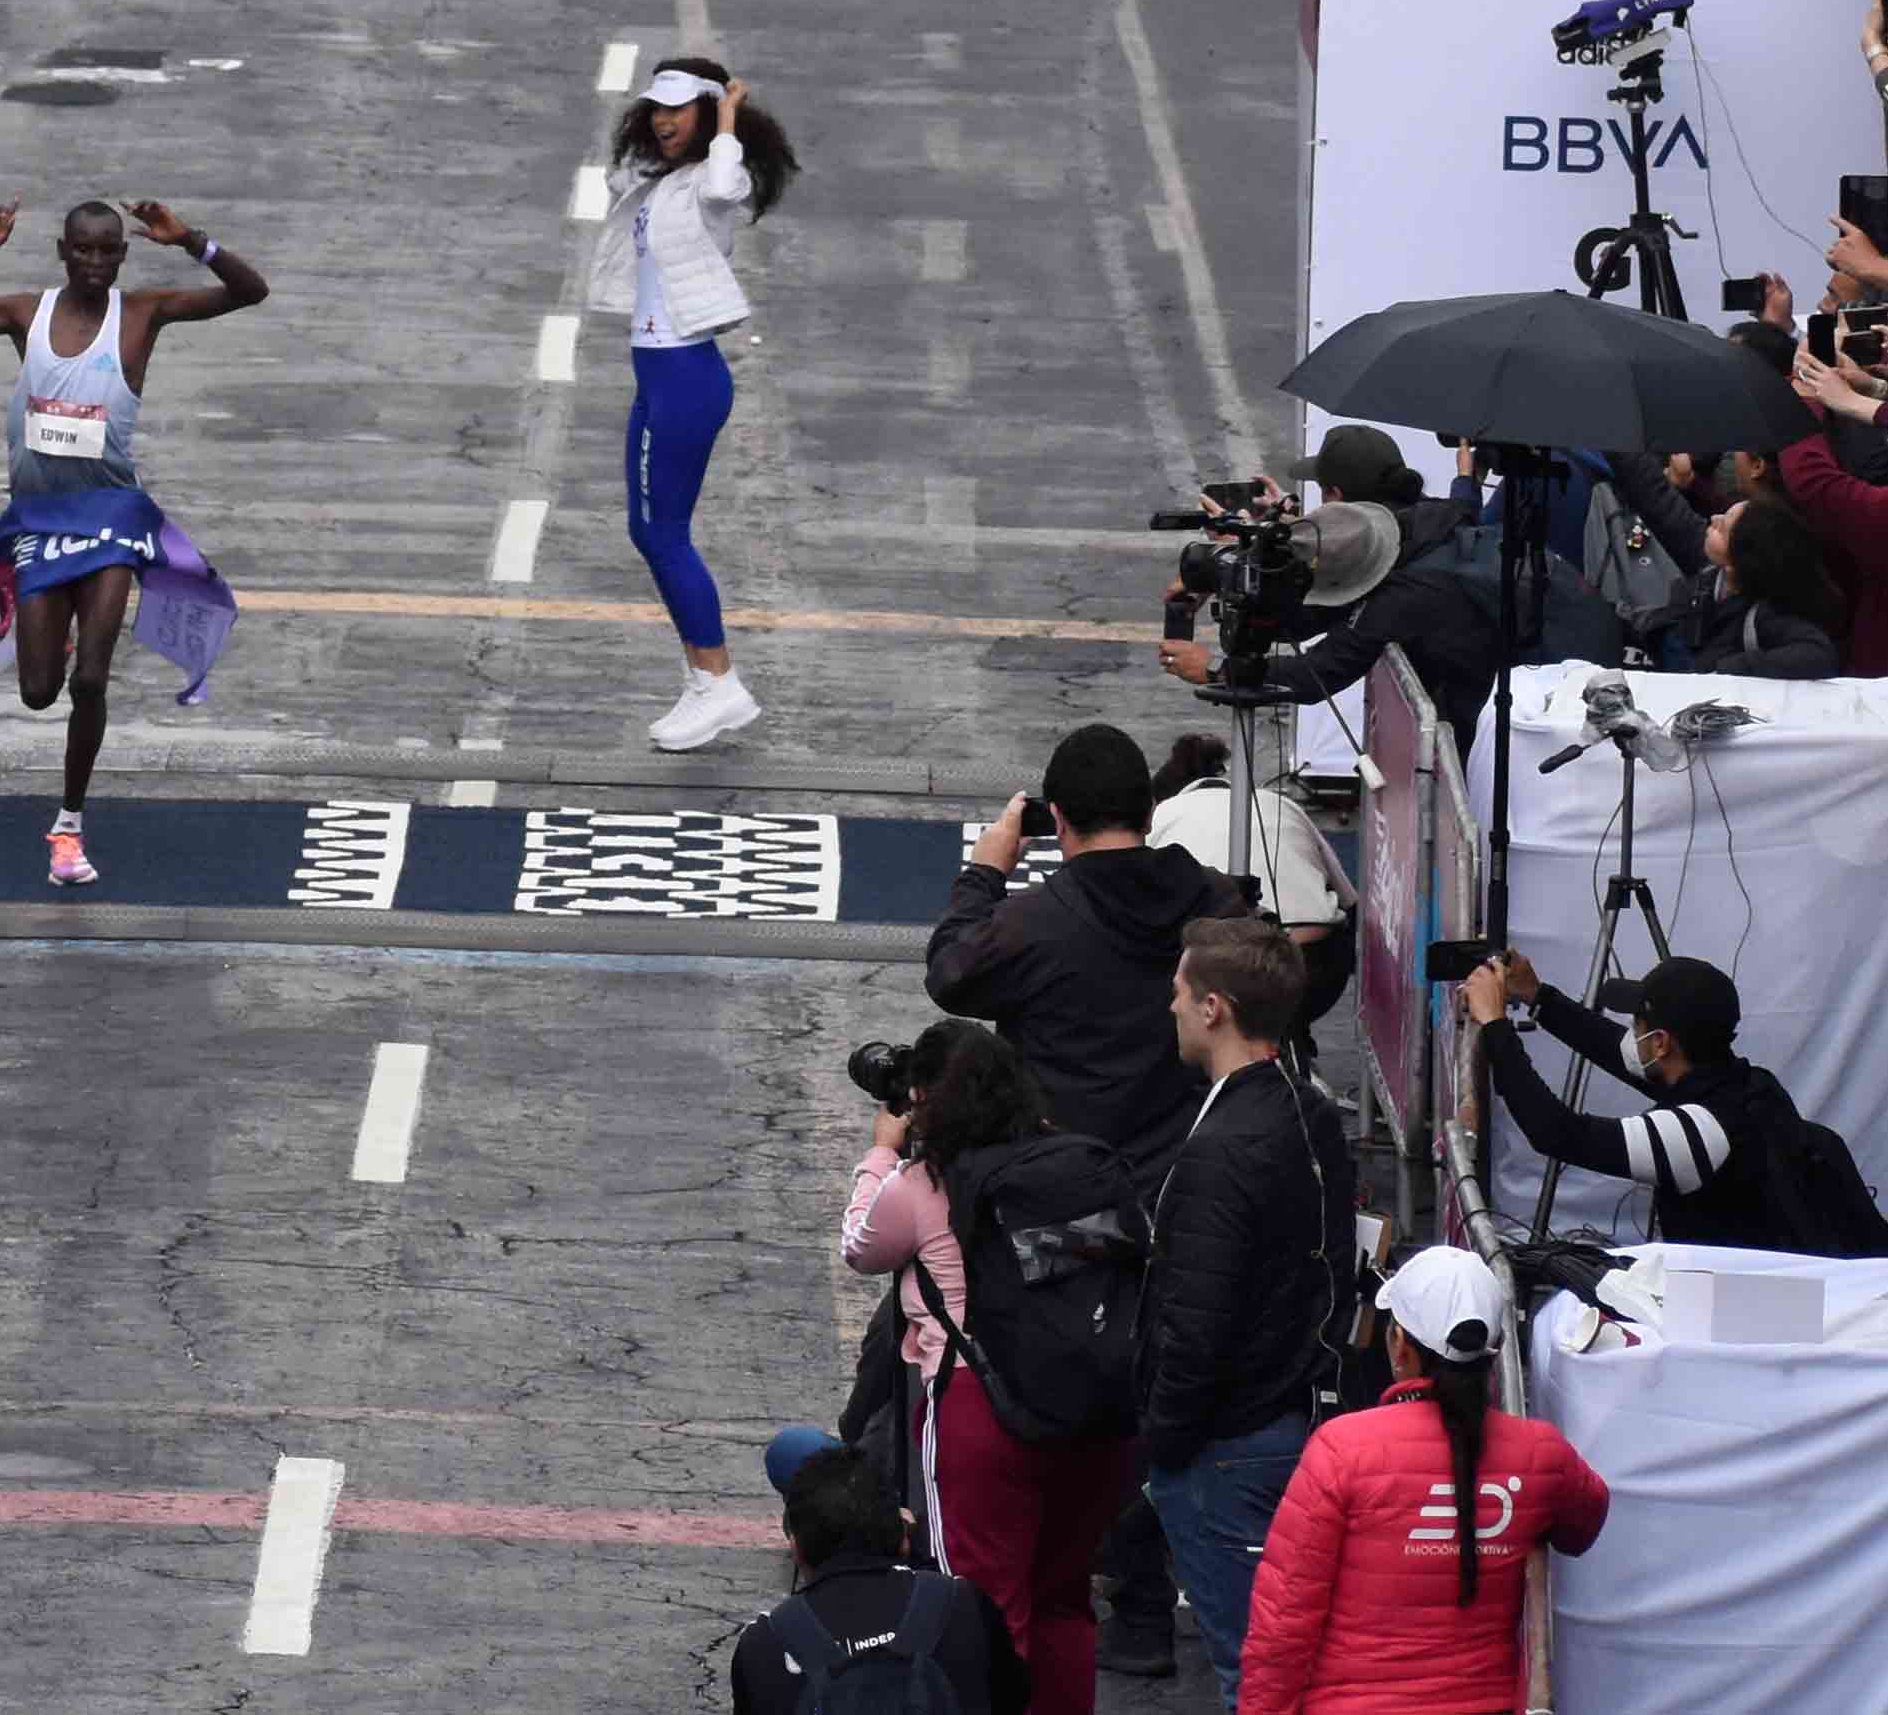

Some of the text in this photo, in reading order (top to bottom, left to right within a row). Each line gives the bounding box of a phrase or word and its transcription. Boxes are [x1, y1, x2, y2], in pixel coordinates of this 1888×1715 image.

[1503, 113, 1709, 173] BBVA
[40, 428, 78, 444] EDWIN
[854, 1631, 896, 1651] INDEP
